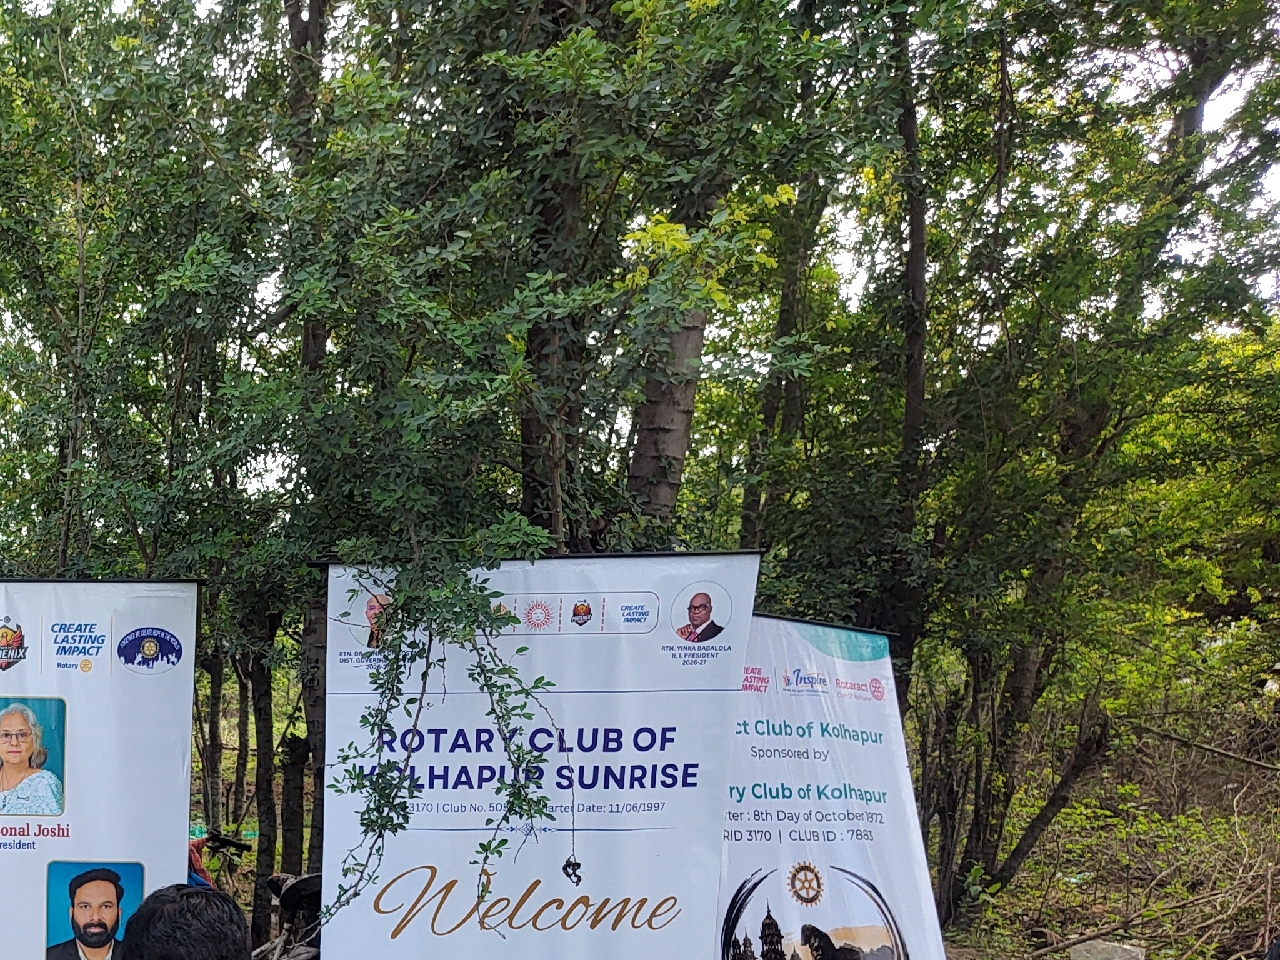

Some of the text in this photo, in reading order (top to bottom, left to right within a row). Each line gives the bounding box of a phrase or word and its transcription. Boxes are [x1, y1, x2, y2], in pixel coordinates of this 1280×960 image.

[50, 623, 97, 634] CREATE
[53, 634, 106, 645] LASTING
[56, 645, 103, 657] IMPACT
[56, 662, 78, 670] Rotary
[792, 668, 828, 689] Inspire
[835, 678, 869, 692] Rotaract
[529, 727, 623, 753] CLUB
[632, 727, 677, 752] OF
[754, 719, 792, 736] Club
[796, 721, 815, 738] of
[820, 722, 883, 746] Kolhapur
[750, 746, 829, 762] Sponsored by
[555, 763, 699, 790] SUNRISE
[751, 783, 793, 800] Club
[797, 784, 812, 800] of
[817, 783, 887, 805] Kolhapur
[408, 802, 433, 813] 3170
[442, 802, 468, 814] Club
[470, 803, 486, 814] No.
[577, 803, 606, 814] Date:
[608, 802, 666, 814] 11/06/1997
[753, 810, 773, 821] 8th
[777, 810, 800, 824] Day
[803, 809, 812, 821] of
[815, 810, 864, 822] October
[34, 823, 70, 838] Joshi
[746, 830, 772, 842] 3170
[788, 830, 819, 842] CLUB
[822, 830, 837, 842] ID
[373, 865, 682, 941] Welcome
